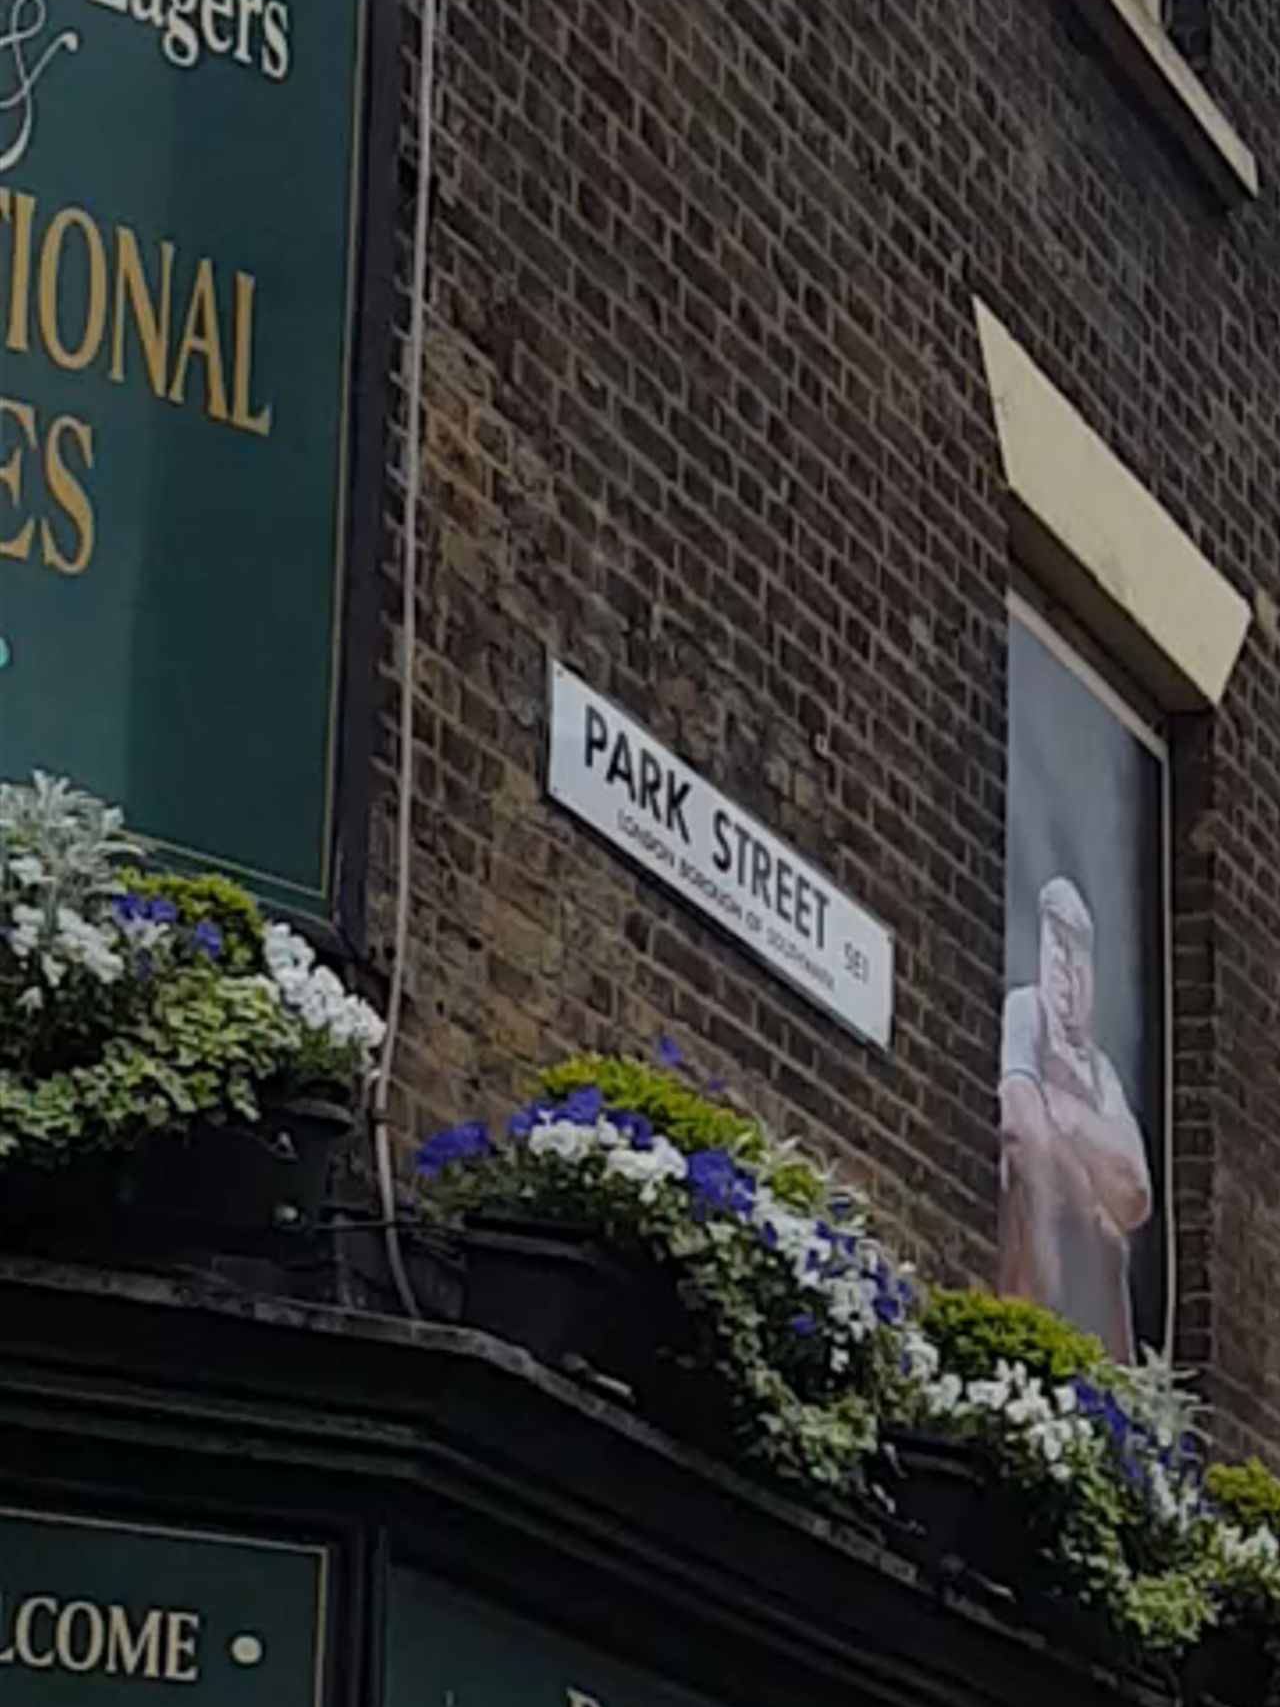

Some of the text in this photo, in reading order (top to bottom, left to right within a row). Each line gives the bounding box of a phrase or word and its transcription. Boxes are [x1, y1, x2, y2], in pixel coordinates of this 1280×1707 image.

[584, 703, 871, 986] PARK STREET SE1
